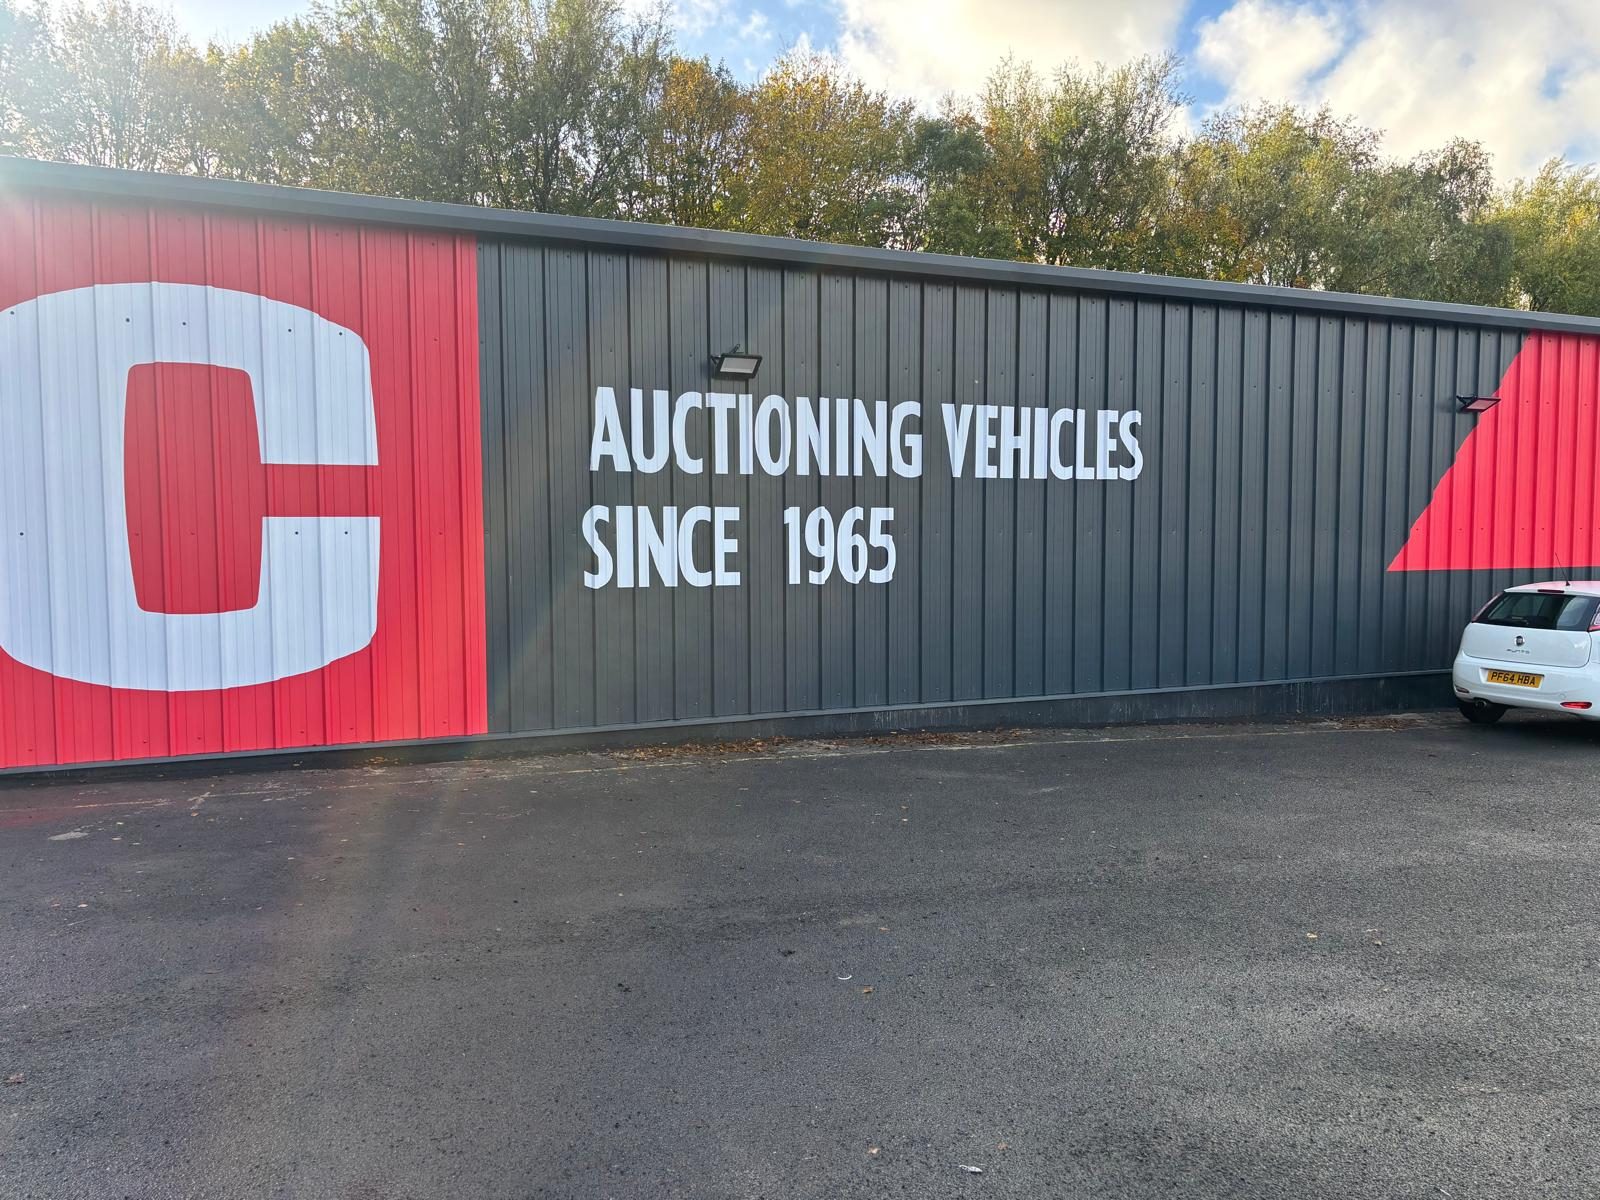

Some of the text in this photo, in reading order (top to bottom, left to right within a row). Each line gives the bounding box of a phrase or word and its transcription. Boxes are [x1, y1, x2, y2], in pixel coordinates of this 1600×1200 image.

[589, 386, 1144, 481] AUCTIONING VEHICLES
[582, 504, 897, 589] SINCE 1965
[1490, 671, 1537, 686] PF64 HBA
